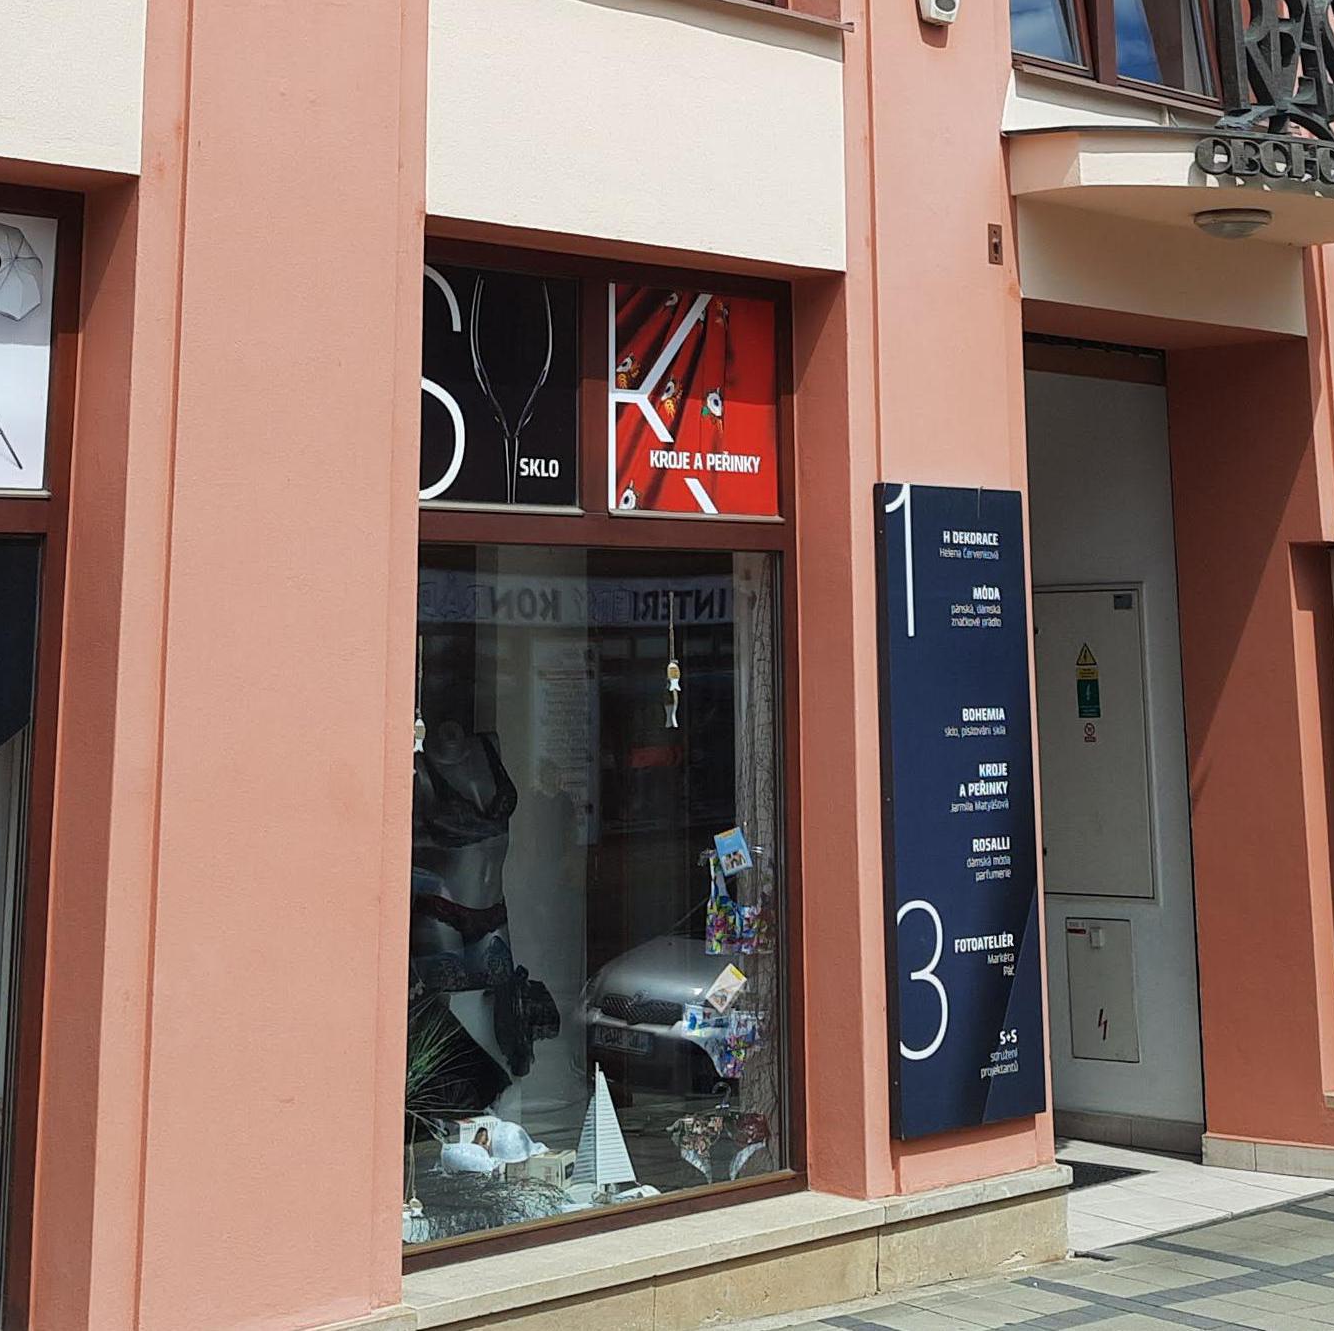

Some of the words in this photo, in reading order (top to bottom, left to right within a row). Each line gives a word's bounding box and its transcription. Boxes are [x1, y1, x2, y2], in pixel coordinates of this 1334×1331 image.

[519, 457, 559, 478] SKLO
[650, 449, 690, 470] KROJE
[693, 452, 703, 470] A
[706, 450, 760, 474] PEŘINKY
[943, 530, 950, 544] H
[952, 531, 999, 546] DEKORACE
[885, 482, 915, 638] 1
[972, 585, 1001, 601] MÓDA
[962, 708, 1005, 721] BOHEMIA
[979, 763, 1007, 777] KROJE
[959, 783, 966, 797] A
[968, 779, 1008, 796] PEŘINKY
[973, 837, 1010, 852] ROSALLI
[954, 931, 1014, 953] FOTOATELIÉR
[896, 900, 948, 1060] 3
